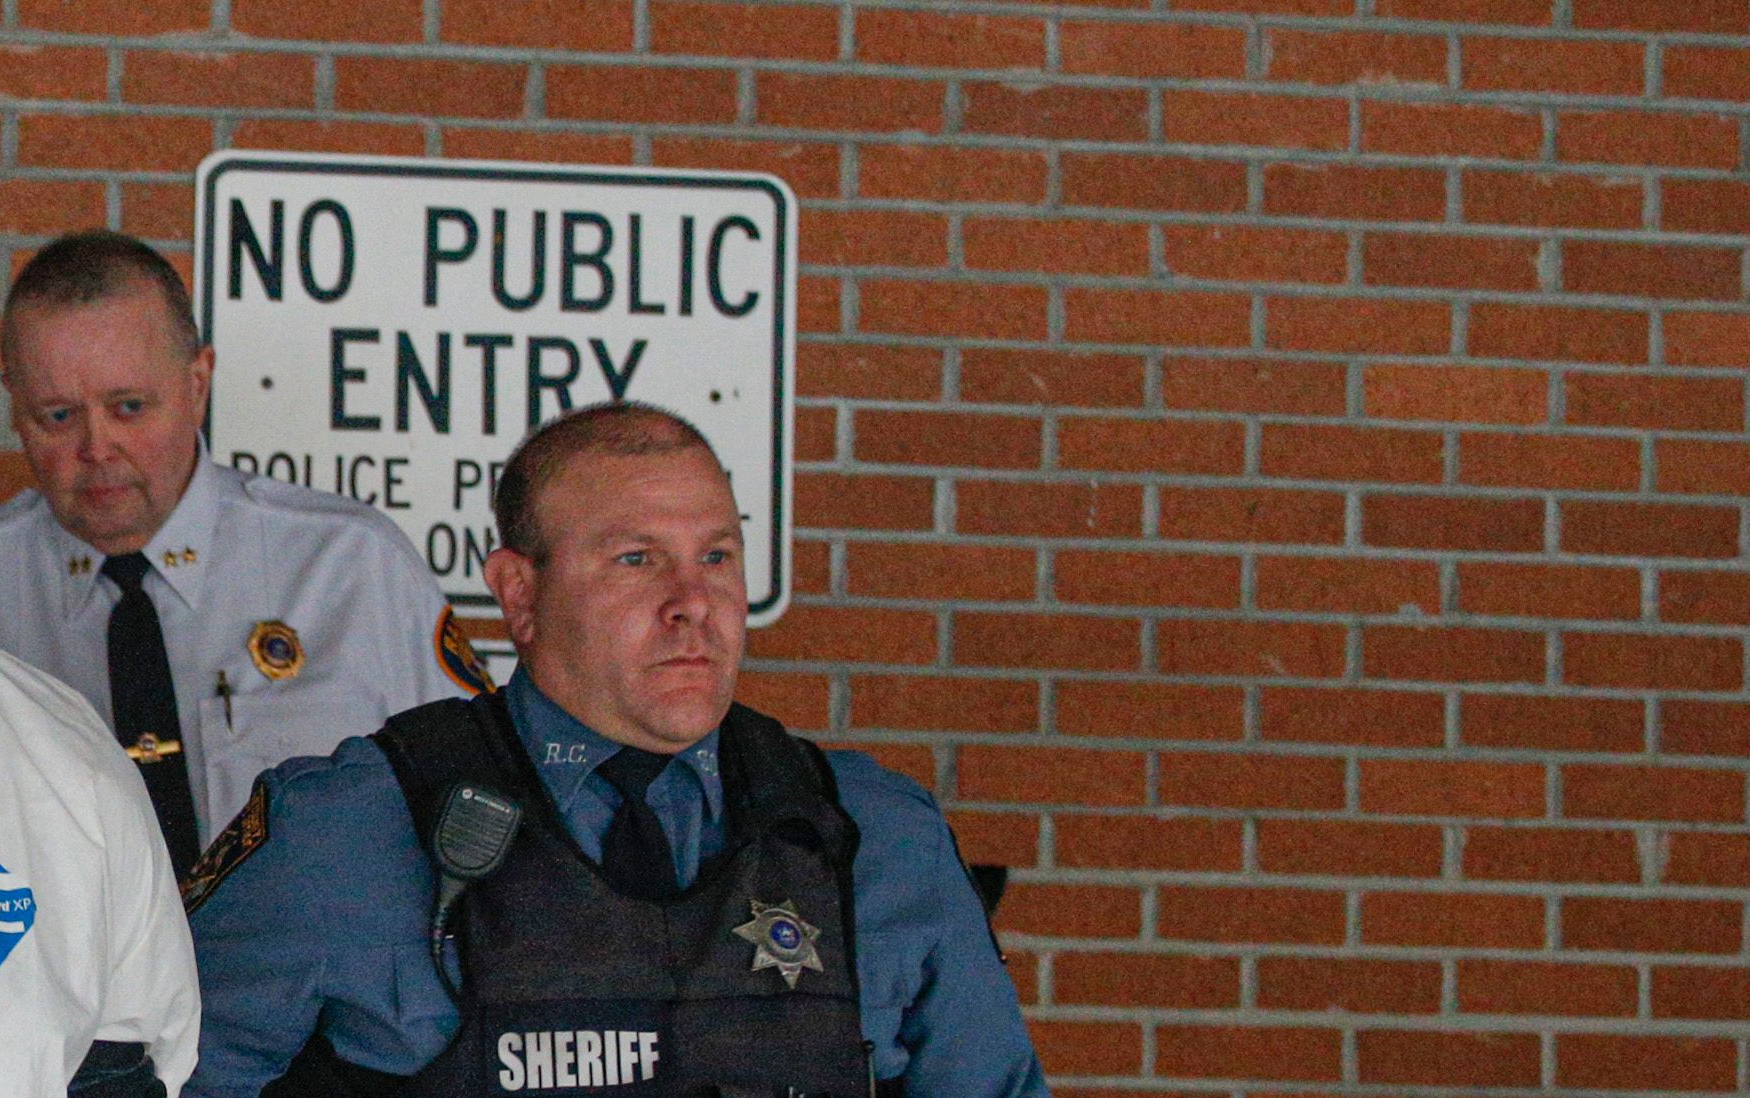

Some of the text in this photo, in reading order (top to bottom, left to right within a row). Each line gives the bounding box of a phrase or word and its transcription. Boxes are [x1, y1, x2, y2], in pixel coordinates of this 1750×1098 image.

[227, 197, 762, 317] NO PUBLIC
[329, 327, 649, 435] ENTRY
[13, 897, 31, 912] XP
[497, 1029, 660, 1092] SHERIFF
